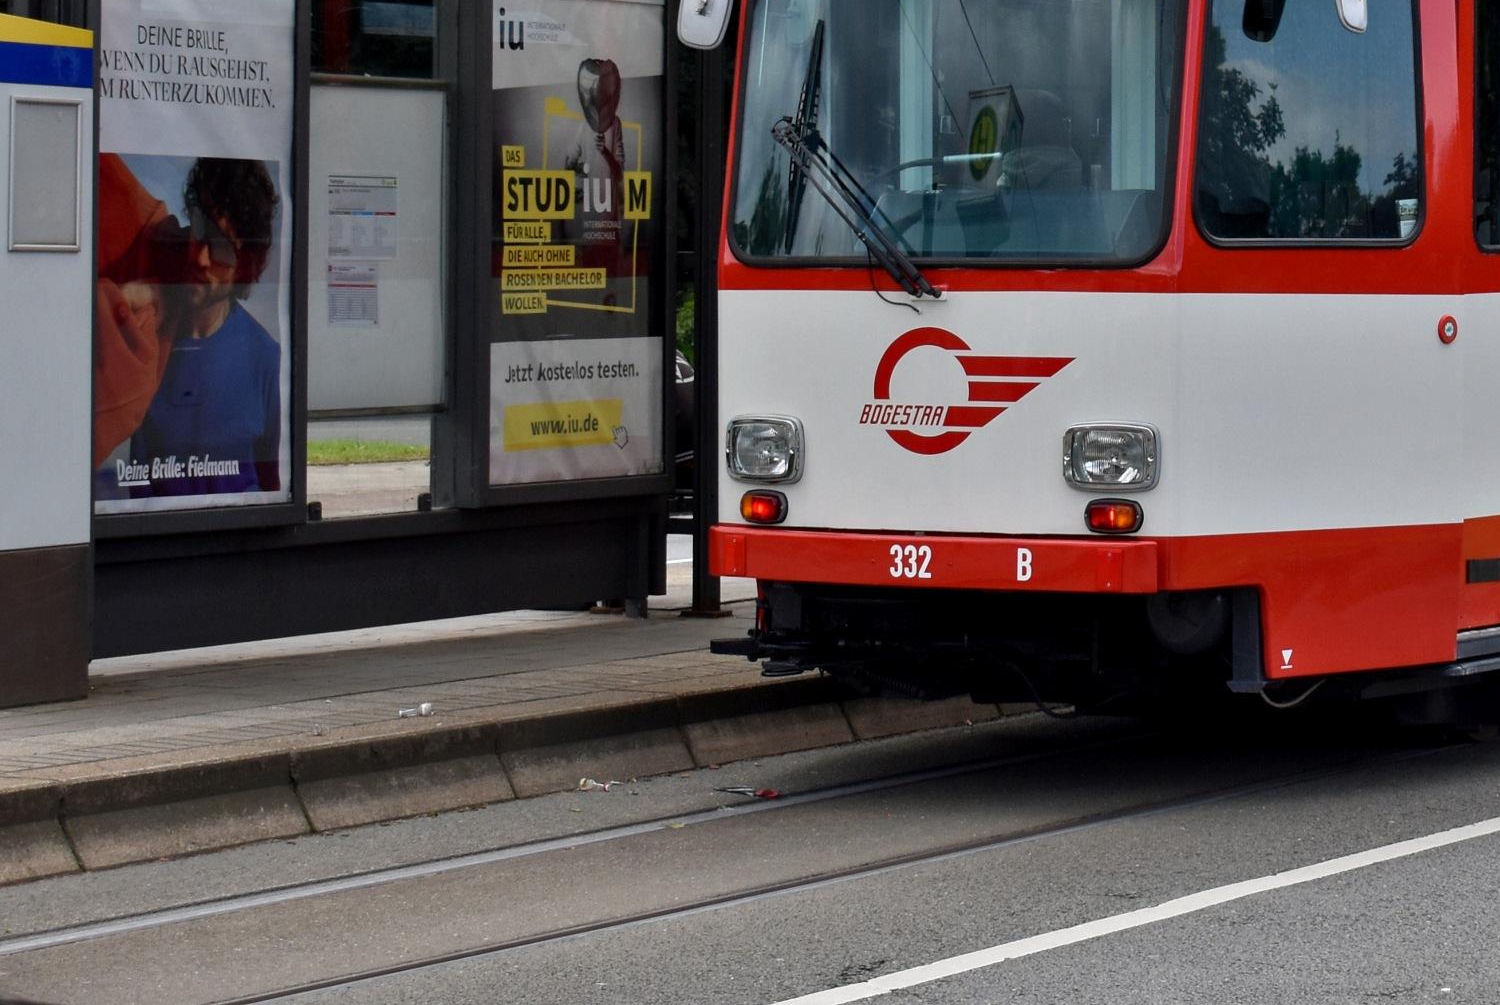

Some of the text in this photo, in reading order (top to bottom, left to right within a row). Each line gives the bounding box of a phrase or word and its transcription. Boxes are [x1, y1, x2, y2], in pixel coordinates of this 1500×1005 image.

[137, 25, 229, 54] DEINE BRILLE,
[499, 7, 524, 50] iu
[150, 53, 172, 75] DU
[119, 79, 275, 109] RUNTERZUKOMMEN.
[506, 149, 521, 163] DAS
[508, 249, 571, 262] DIE AUCH OHNE
[555, 272, 602, 286] BACHELOR
[505, 363, 533, 383] Jetzt
[597, 359, 640, 379] testen.
[530, 412, 599, 436] www.iu.de
[859, 404, 944, 426] BOGESTRA
[116, 453, 240, 482] Deine Brille: Fielmann
[890, 544, 1033, 581] 332 B
